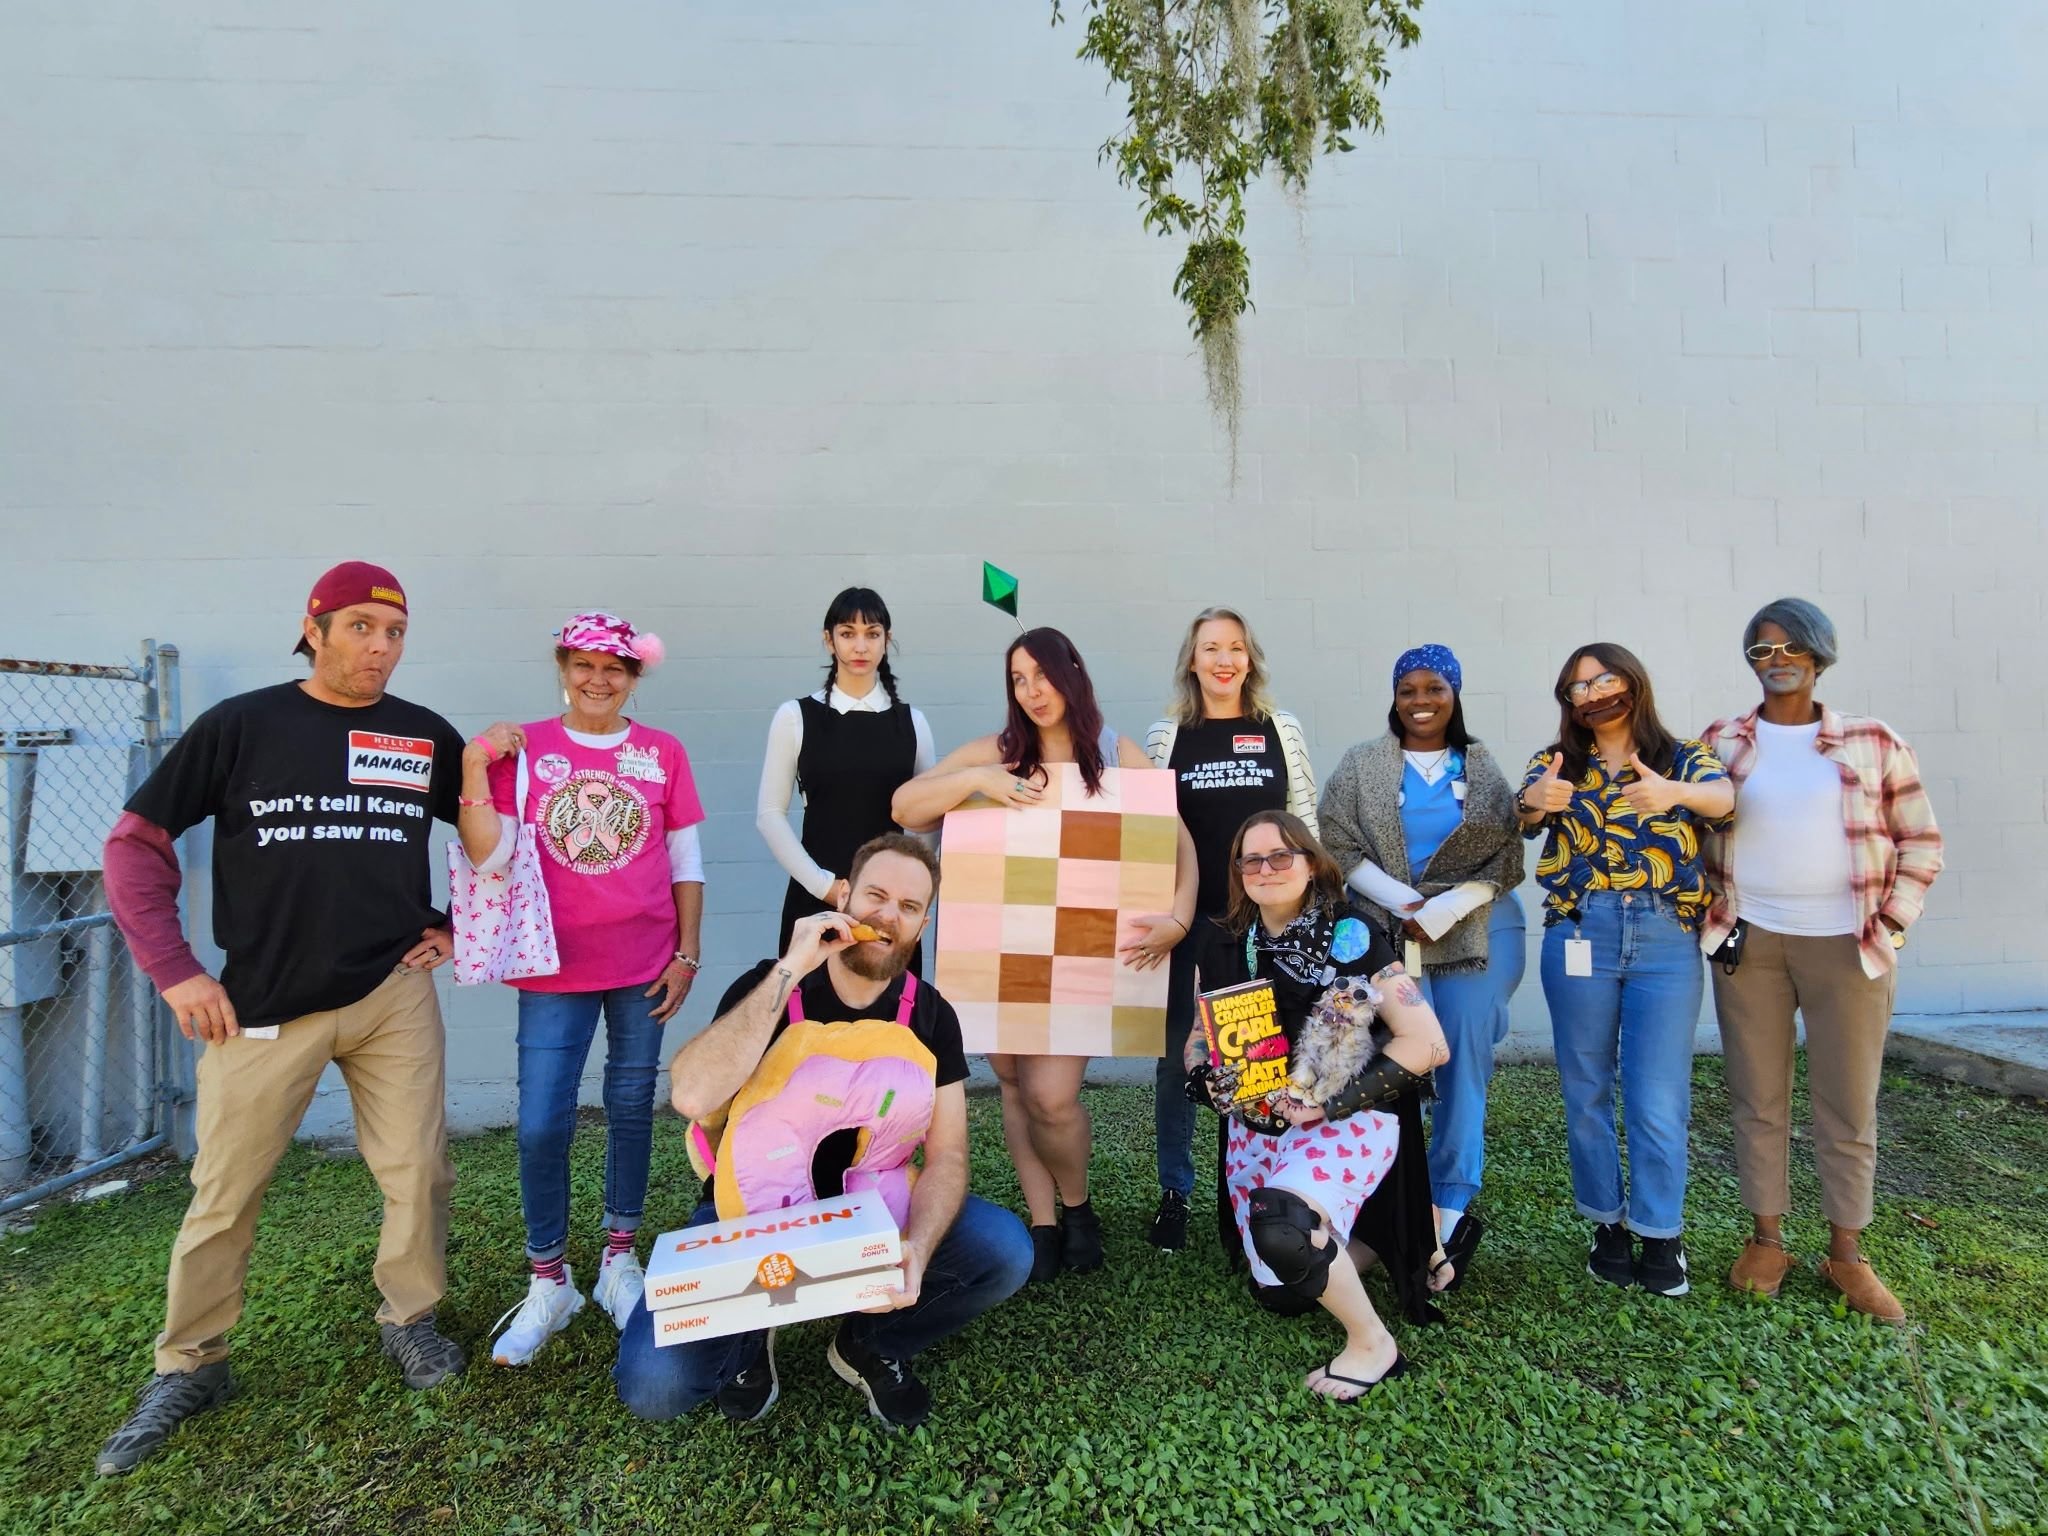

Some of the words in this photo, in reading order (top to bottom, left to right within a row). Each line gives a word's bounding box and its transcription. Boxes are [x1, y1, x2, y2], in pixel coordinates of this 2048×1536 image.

[374, 736, 414, 748] HELLO
[354, 753, 431, 776] MANAGER
[1180, 770, 1225, 782] SPEAK
[1226, 768, 1246, 777] TO
[1247, 768, 1274, 778] THE
[1195, 764, 1200, 772] I
[1202, 760, 1237, 771] NEED
[1238, 760, 1257, 768] TO
[574, 769, 616, 783] STRENGTH
[1191, 776, 1264, 790] MANAGER
[618, 780, 647, 806] COURAGE
[249, 794, 314, 817] Don't
[319, 794, 361, 812] tell
[367, 796, 424, 819] Karen
[550, 796, 641, 848] fight
[257, 825, 306, 847] you
[312, 825, 364, 840] saw
[369, 826, 408, 843] me.
[537, 826, 569, 868] AWARENESS
[571, 863, 611, 875] SUPPORT
[615, 853, 633, 870] LOVE
[1212, 987, 1275, 1014] DUNGEON
[1214, 1000, 1277, 1026] CRAWLER
[1218, 1013, 1282, 1058] CARL
[675, 1206, 862, 1253] DUNKIN'
[861, 1249, 889, 1258] DONUTS
[864, 1243, 886, 1252] DOZEN
[763, 1262, 778, 1287] OVER
[770, 1254, 784, 1277] WAIT
[780, 1257, 792, 1278] THE
[655, 1280, 702, 1298] DUNKIN'
[663, 1316, 710, 1333] DUNKIN'
